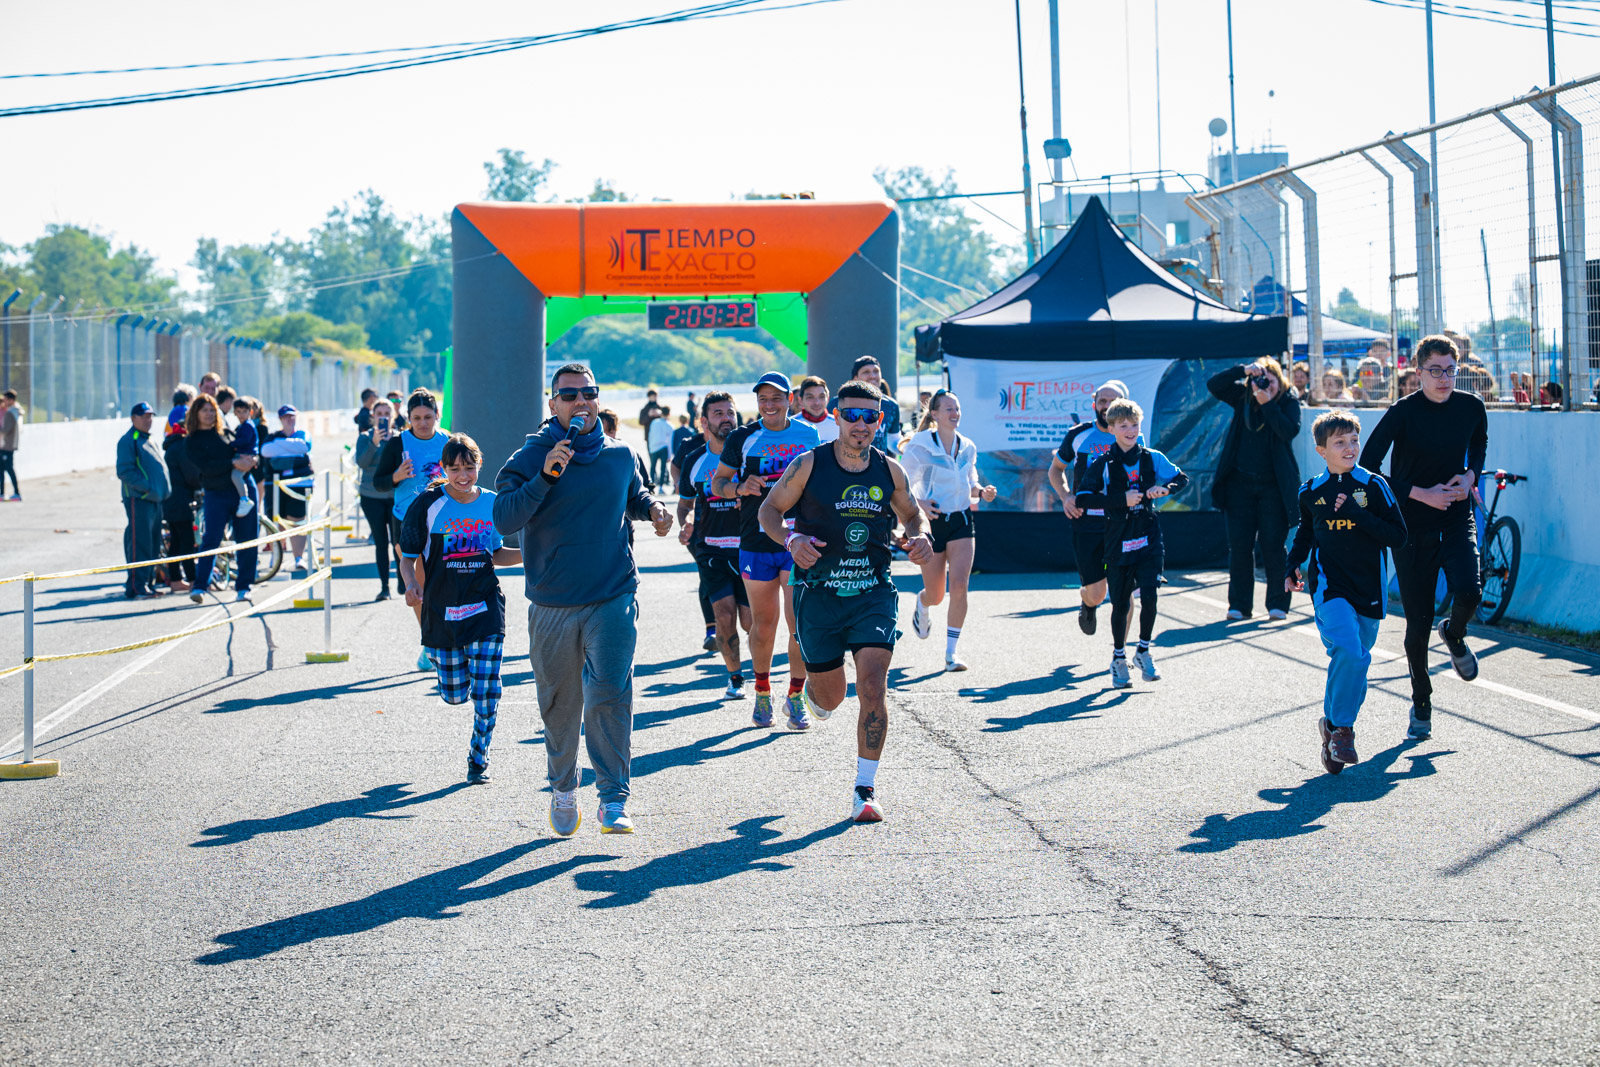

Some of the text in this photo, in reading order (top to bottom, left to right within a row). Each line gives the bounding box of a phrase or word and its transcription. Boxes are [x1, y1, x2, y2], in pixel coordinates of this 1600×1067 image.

[606, 273, 661, 281] Cronometraje
[709, 272, 756, 281] Deportivos
[664, 302, 755, 329] 2:09:32
[872, 488, 881, 500] 3
[835, 500, 883, 513] EGUSQUIZA
[839, 554, 870, 569] MEDIA
[823, 575, 880, 591] NOCTURNA
